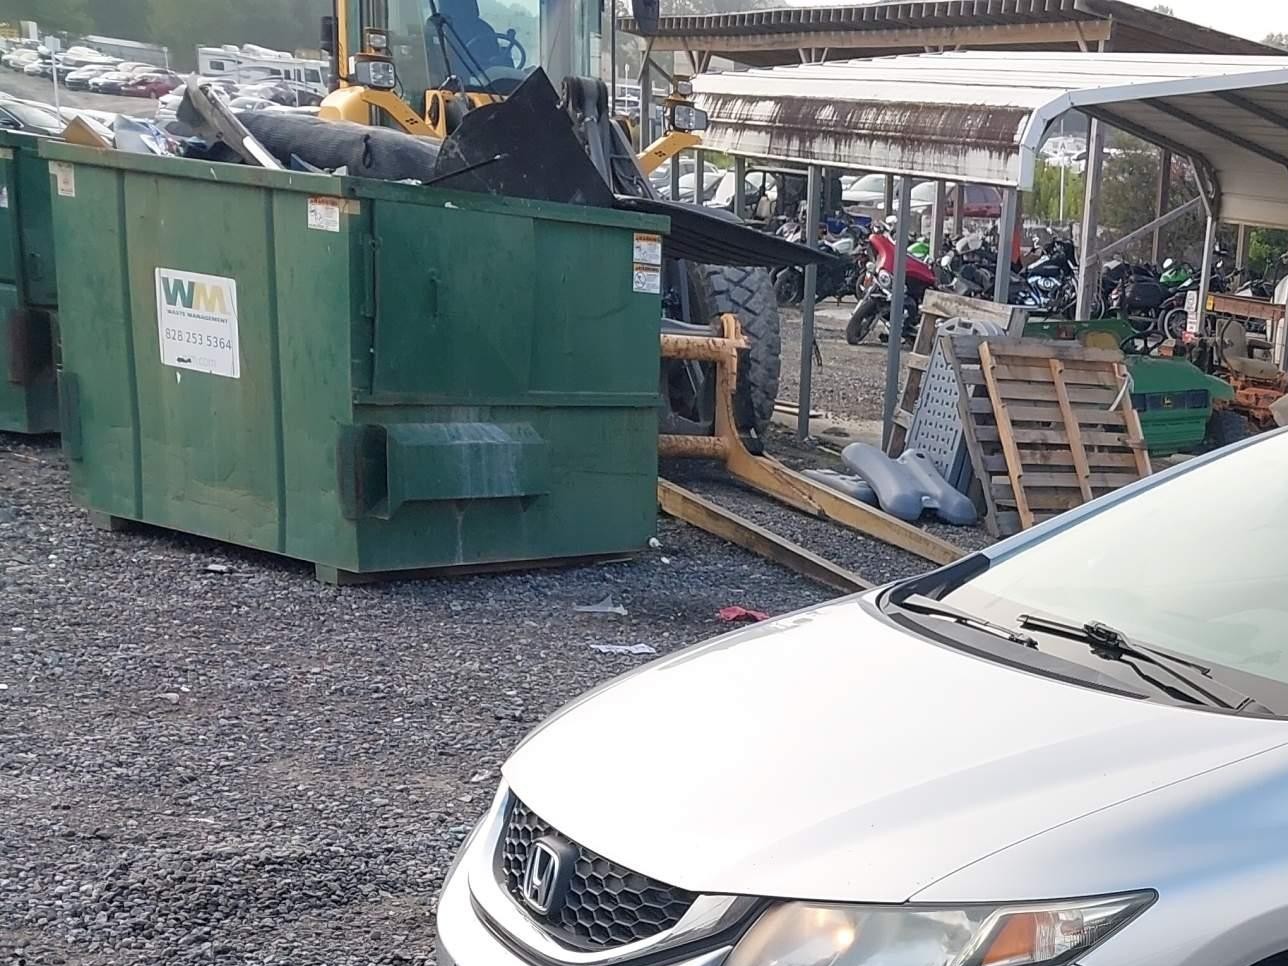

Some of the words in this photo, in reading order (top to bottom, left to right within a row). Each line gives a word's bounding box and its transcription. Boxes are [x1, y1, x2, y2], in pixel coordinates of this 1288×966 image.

[162, 277, 228, 313] WM
[187, 313, 228, 324] MANAGEMENT
[165, 327, 183, 342] 828
[186, 331, 203, 346] 253
[206, 335, 232, 351] 5364
